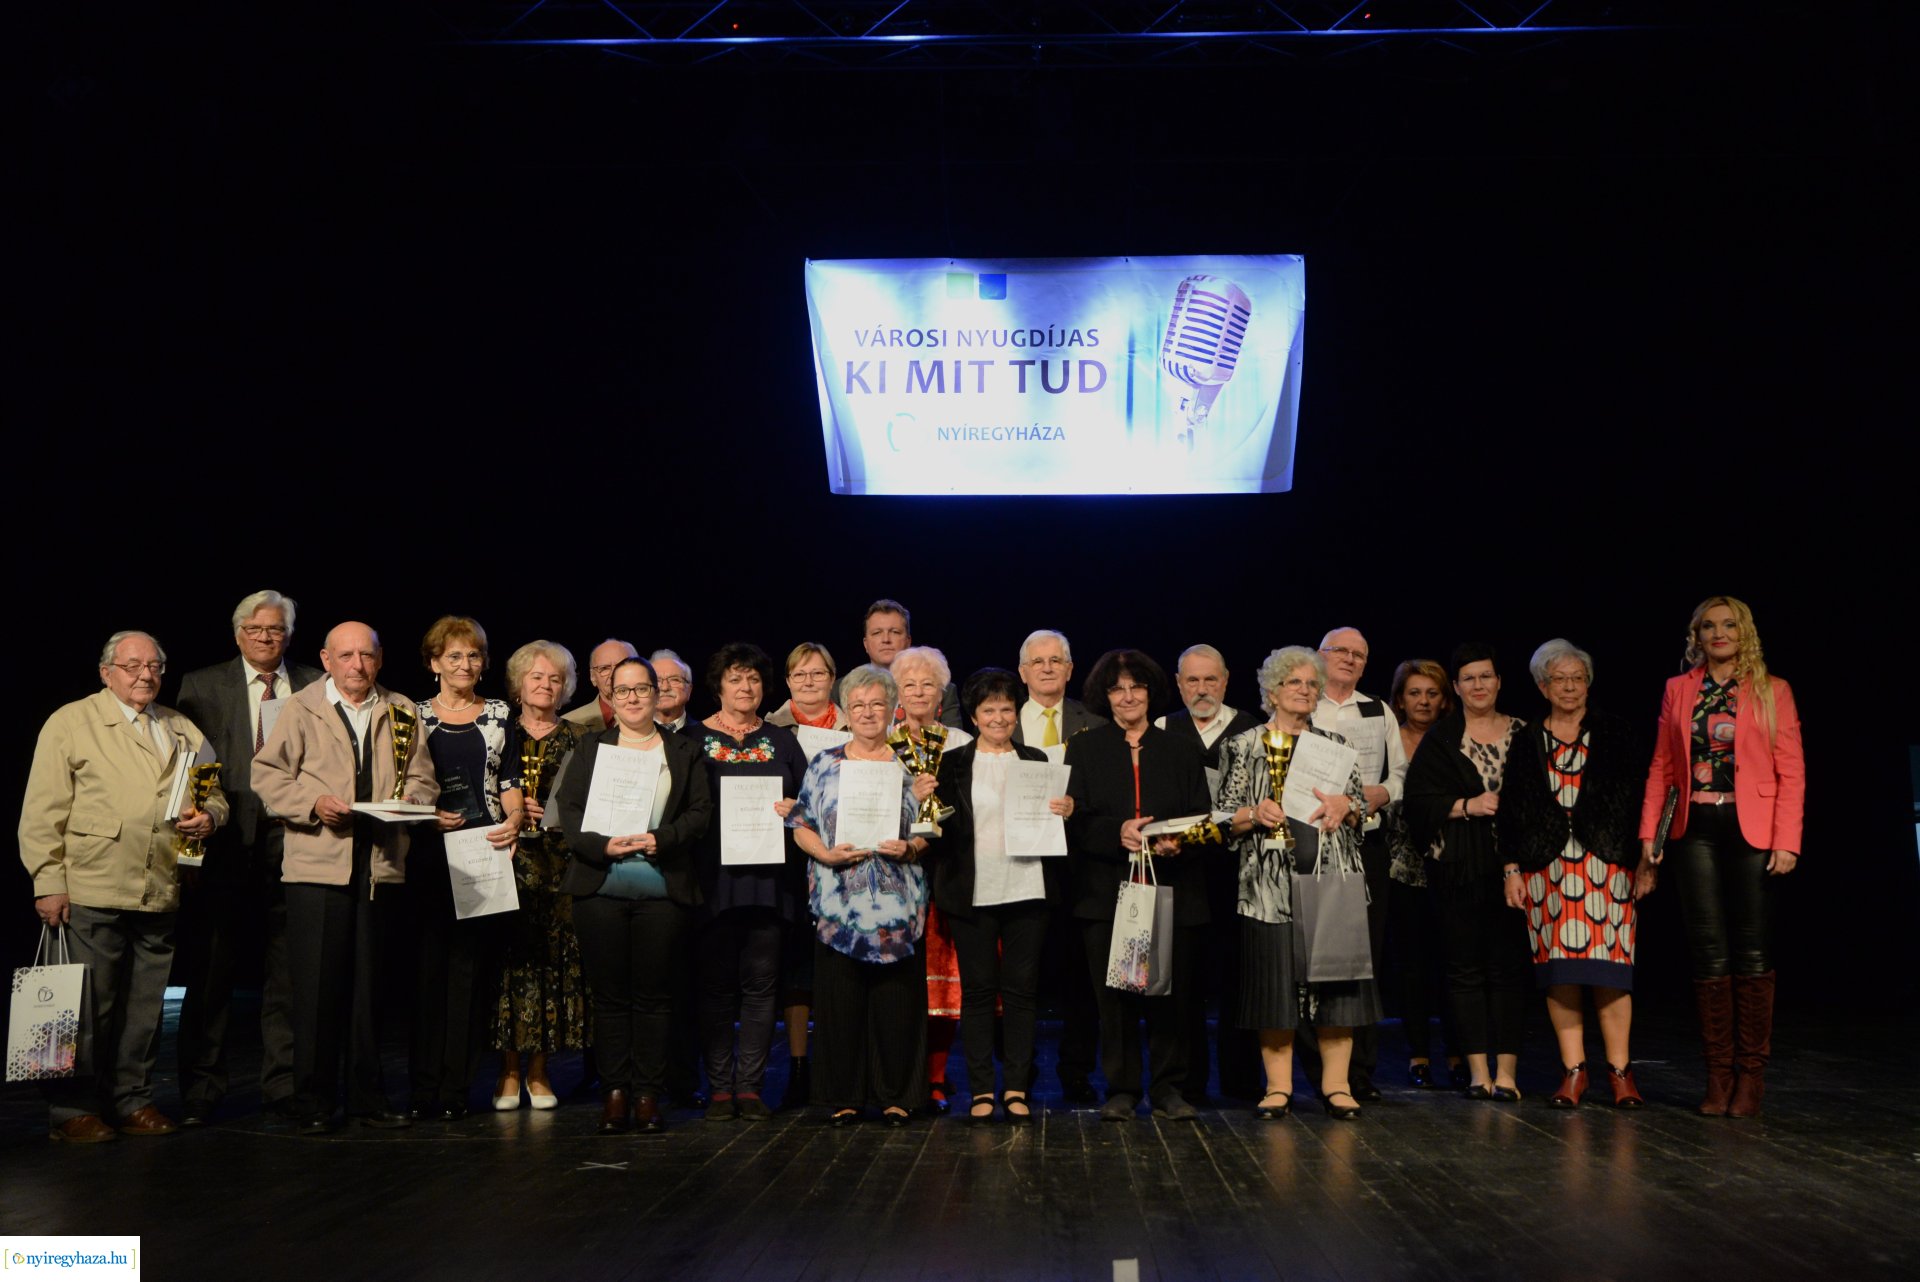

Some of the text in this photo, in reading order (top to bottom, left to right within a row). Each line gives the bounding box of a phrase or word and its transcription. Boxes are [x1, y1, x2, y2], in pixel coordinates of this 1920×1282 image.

[854, 324, 1100, 348] VÁROSI NYUGDÍJAS
[845, 359, 1108, 394] KI MIT TUD
[937, 423, 1066, 441] NYÍREGYHÁZA
